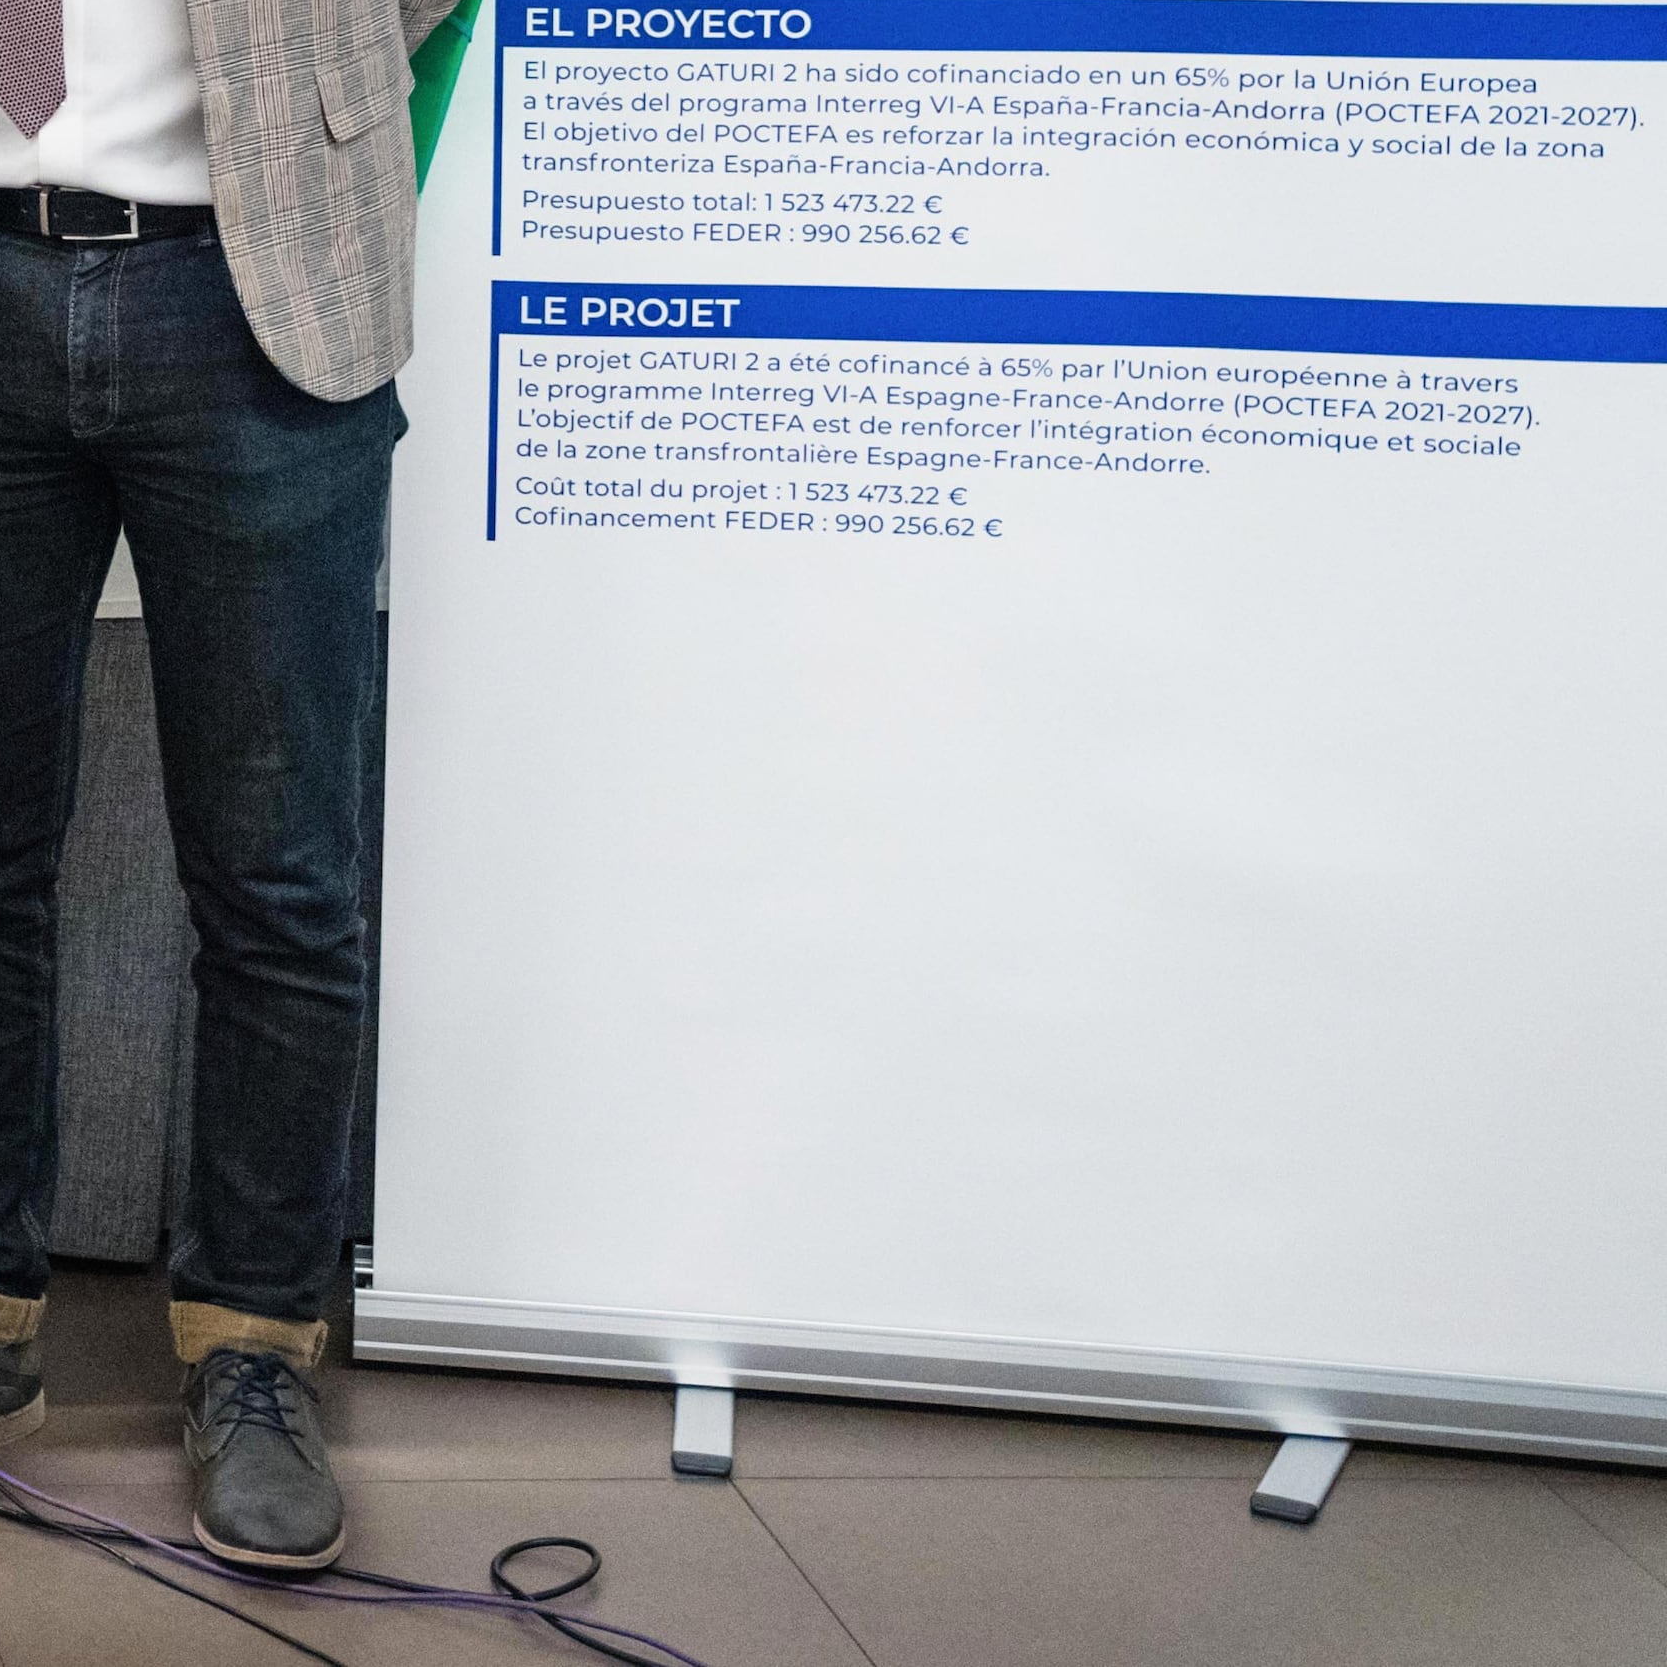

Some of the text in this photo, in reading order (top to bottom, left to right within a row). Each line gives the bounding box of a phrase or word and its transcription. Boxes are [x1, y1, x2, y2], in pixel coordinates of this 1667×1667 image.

[520, 295, 741, 328] LE PROJET
[519, 348, 1519, 394] Le projet GATURI 2 a été cofinancé à 65% par l’Union européenne à travers
[518, 377, 1540, 430] le programme Interreg VI-A Espagne-France-Andorre (POCTEFA 2021-2027).
[516, 437, 1210, 474] de la zone transfrontalière Espagne-France-Andorre.
[518, 408, 1521, 457] L’objectif de POCTEFA est de renforcer l’intégration économique et sociale
